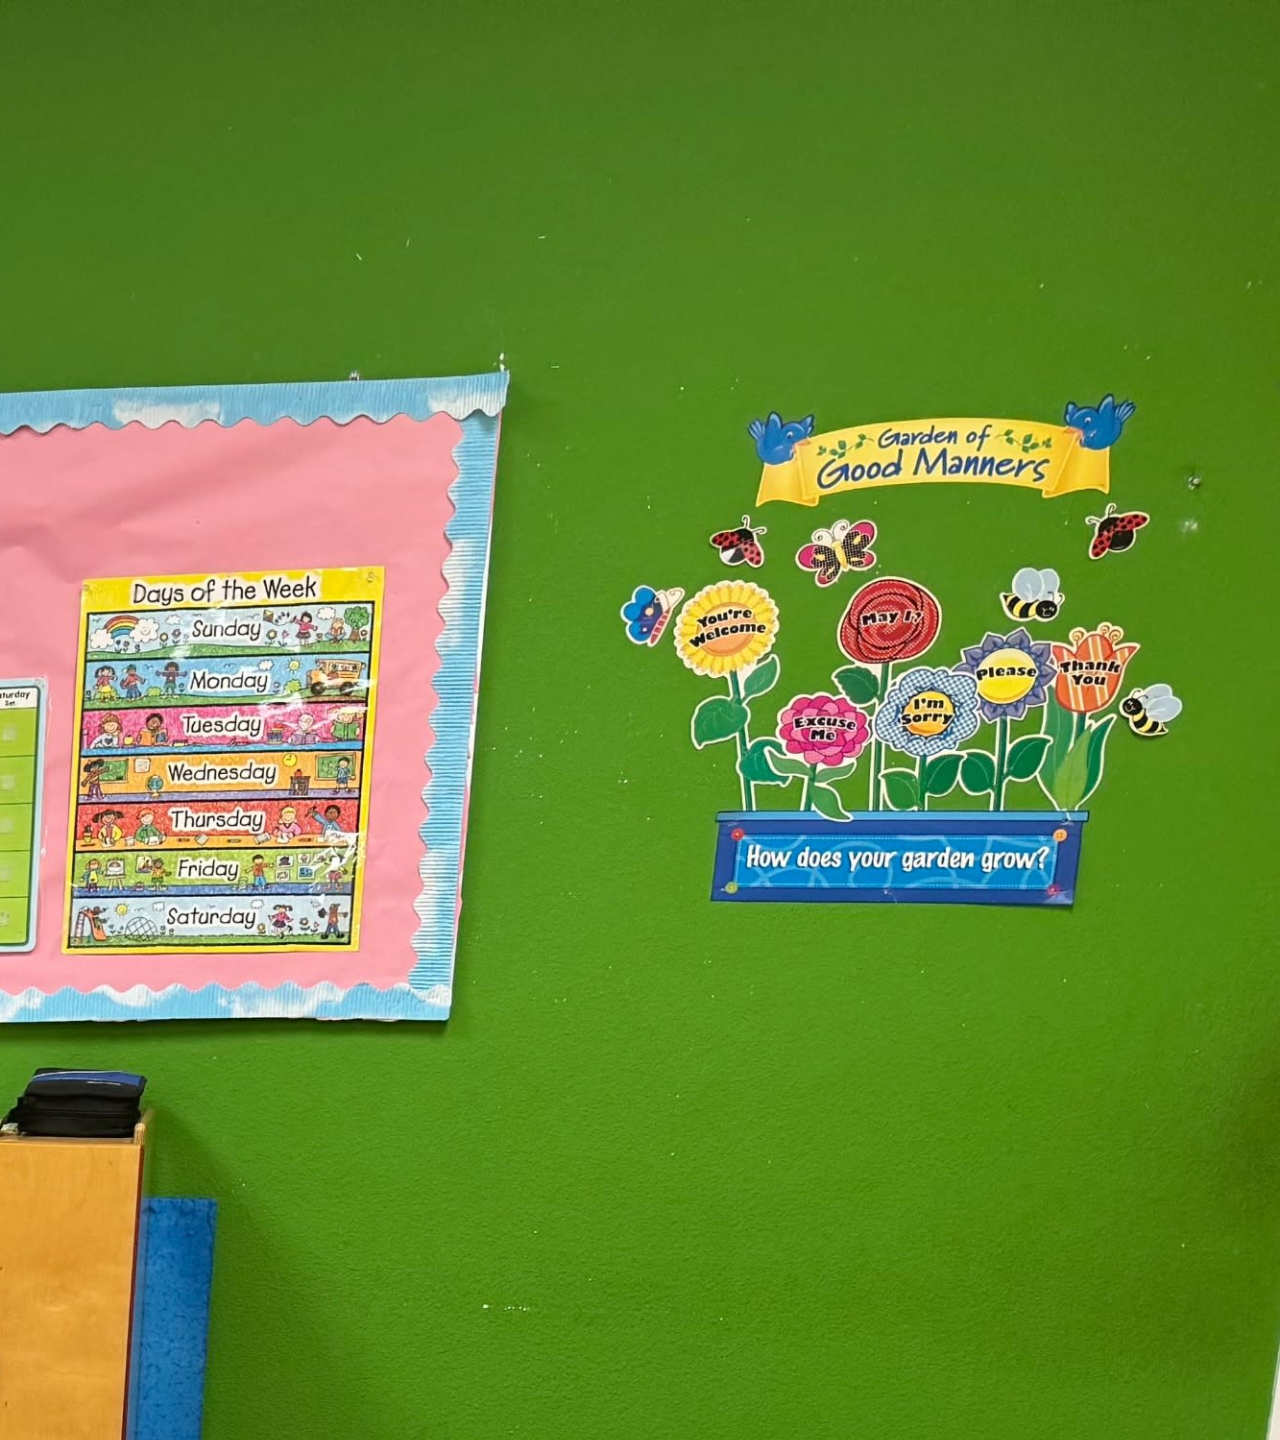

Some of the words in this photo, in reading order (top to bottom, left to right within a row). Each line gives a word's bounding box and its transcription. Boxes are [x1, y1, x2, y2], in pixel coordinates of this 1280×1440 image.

[878, 426, 959, 447] Garden
[966, 425, 992, 448] of
[817, 455, 901, 489] Good
[913, 449, 1050, 482] Manners
[133, 583, 185, 605] Days
[191, 580, 215, 602] of
[222, 581, 257, 600] the
[263, 576, 317, 598] Week
[696, 607, 752, 628] You're
[861, 612, 897, 627] May
[902, 610, 923, 625] I?
[192, 620, 261, 640] Sunday
[688, 621, 766, 648] Welcome
[976, 664, 1036, 680] Please
[1059, 660, 1120, 675] Thank
[190, 670, 268, 692] Monday
[1071, 674, 1106, 687] You
[914, 697, 945, 711] I'm
[182, 714, 262, 736] Tuesday
[794, 717, 856, 731] Excuse
[901, 711, 952, 727] Sorry
[810, 728, 835, 741] Me
[168, 763, 277, 783] Wednesday
[171, 809, 264, 831] Thursday
[177, 859, 239, 880] Friday
[746, 845, 791, 869] How
[797, 845, 841, 868] does
[848, 849, 897, 874] your
[902, 846, 977, 873] garden
[982, 845, 1050, 875] grow?
[167, 907, 257, 928] Saturday
